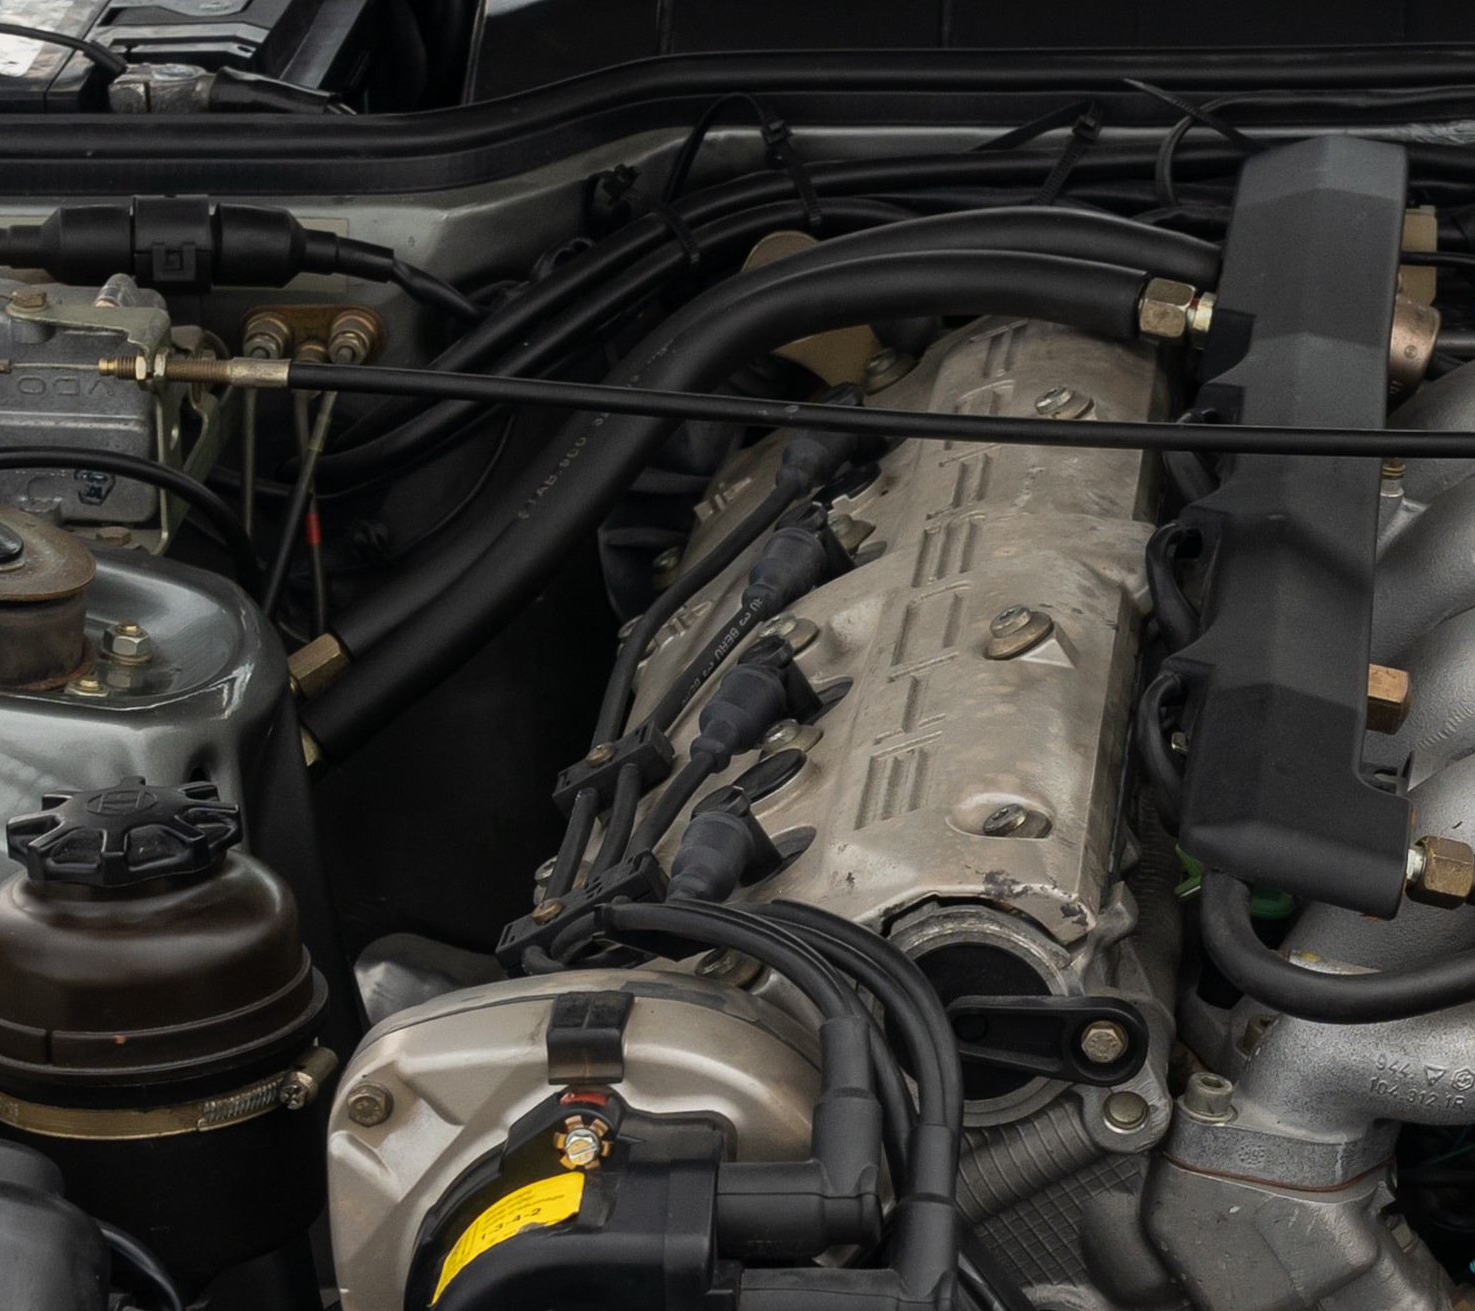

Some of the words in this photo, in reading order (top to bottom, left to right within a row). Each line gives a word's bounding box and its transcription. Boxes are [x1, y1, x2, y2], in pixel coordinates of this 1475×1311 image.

[18, 375, 114, 398] VDO
[713, 626, 740, 660] BERU
[481, 1207, 542, 1241] 1-3-4-2
